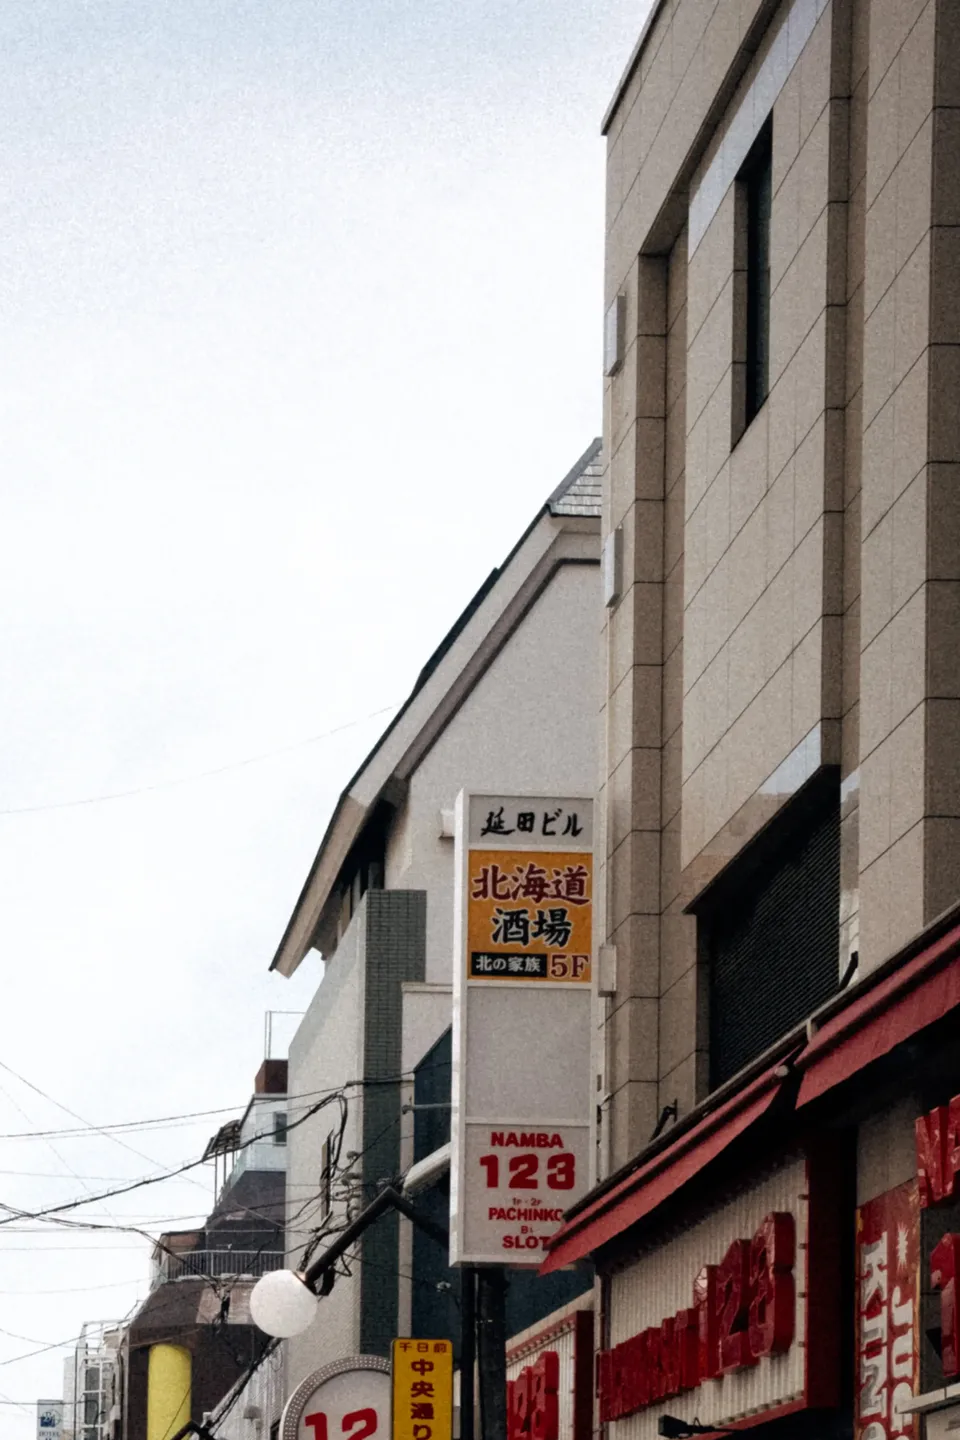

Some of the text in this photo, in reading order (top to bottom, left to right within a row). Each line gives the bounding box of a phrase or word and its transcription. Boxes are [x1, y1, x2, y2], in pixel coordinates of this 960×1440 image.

[472, 863, 591, 906] 北海道
[491, 907, 573, 948] 酒場
[476, 954, 590, 978] 北の家族 5F
[490, 1131, 564, 1148] NAMBA
[479, 1152, 575, 1190] 123
[398, 1342, 447, 1353] 千日前
